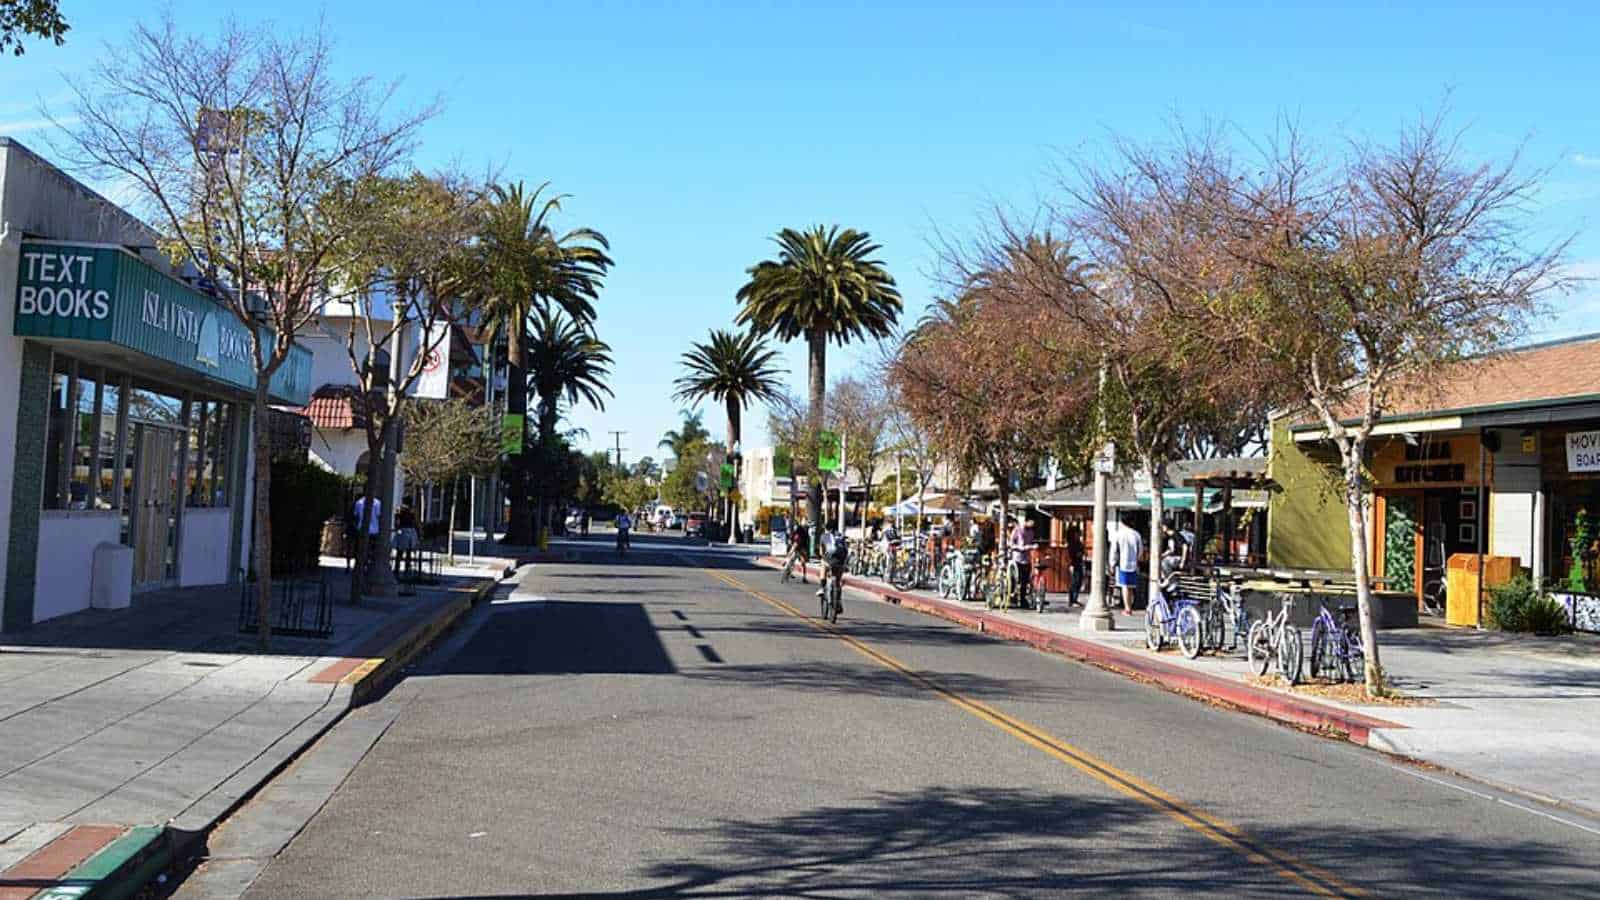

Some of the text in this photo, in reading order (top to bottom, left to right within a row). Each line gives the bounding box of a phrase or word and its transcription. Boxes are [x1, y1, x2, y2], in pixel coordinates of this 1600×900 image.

[24, 253, 94, 284] TEXT
[19, 286, 110, 319] BOOKS
[142, 288, 168, 331] ISLA
[170, 302, 199, 345] VISTA
